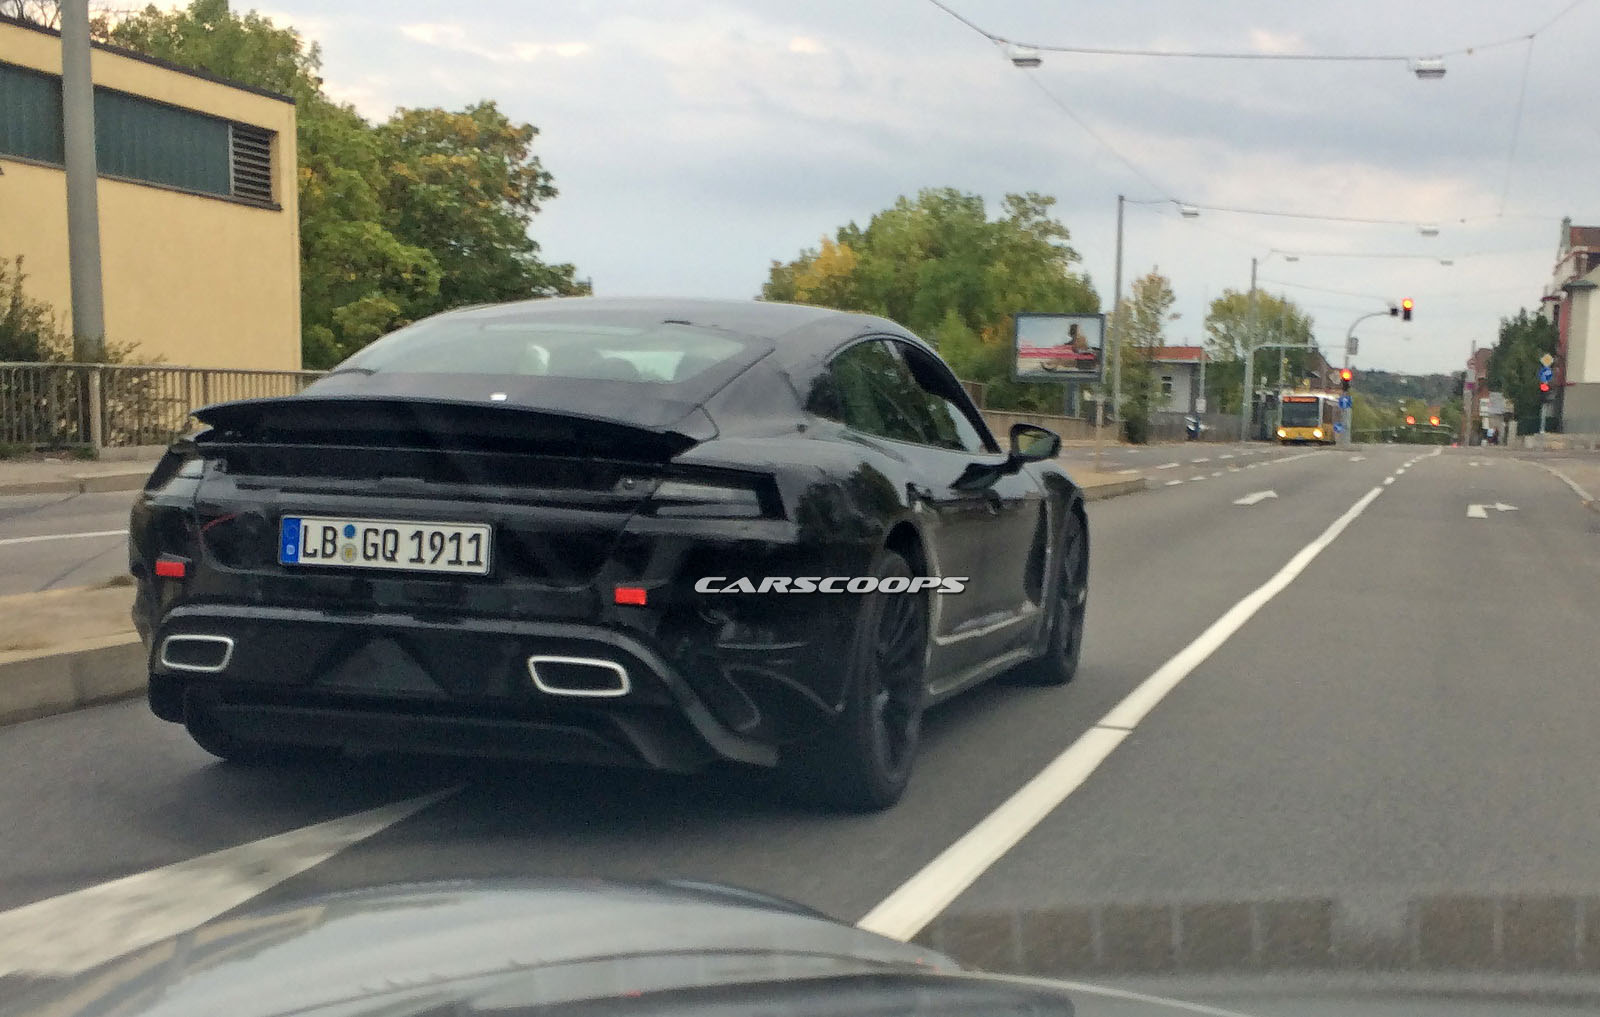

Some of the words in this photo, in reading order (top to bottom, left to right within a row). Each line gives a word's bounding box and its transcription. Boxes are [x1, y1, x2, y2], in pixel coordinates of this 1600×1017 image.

[302, 525, 338, 559] LB
[362, 527, 400, 562] GQ
[408, 529, 483, 567] 1911
